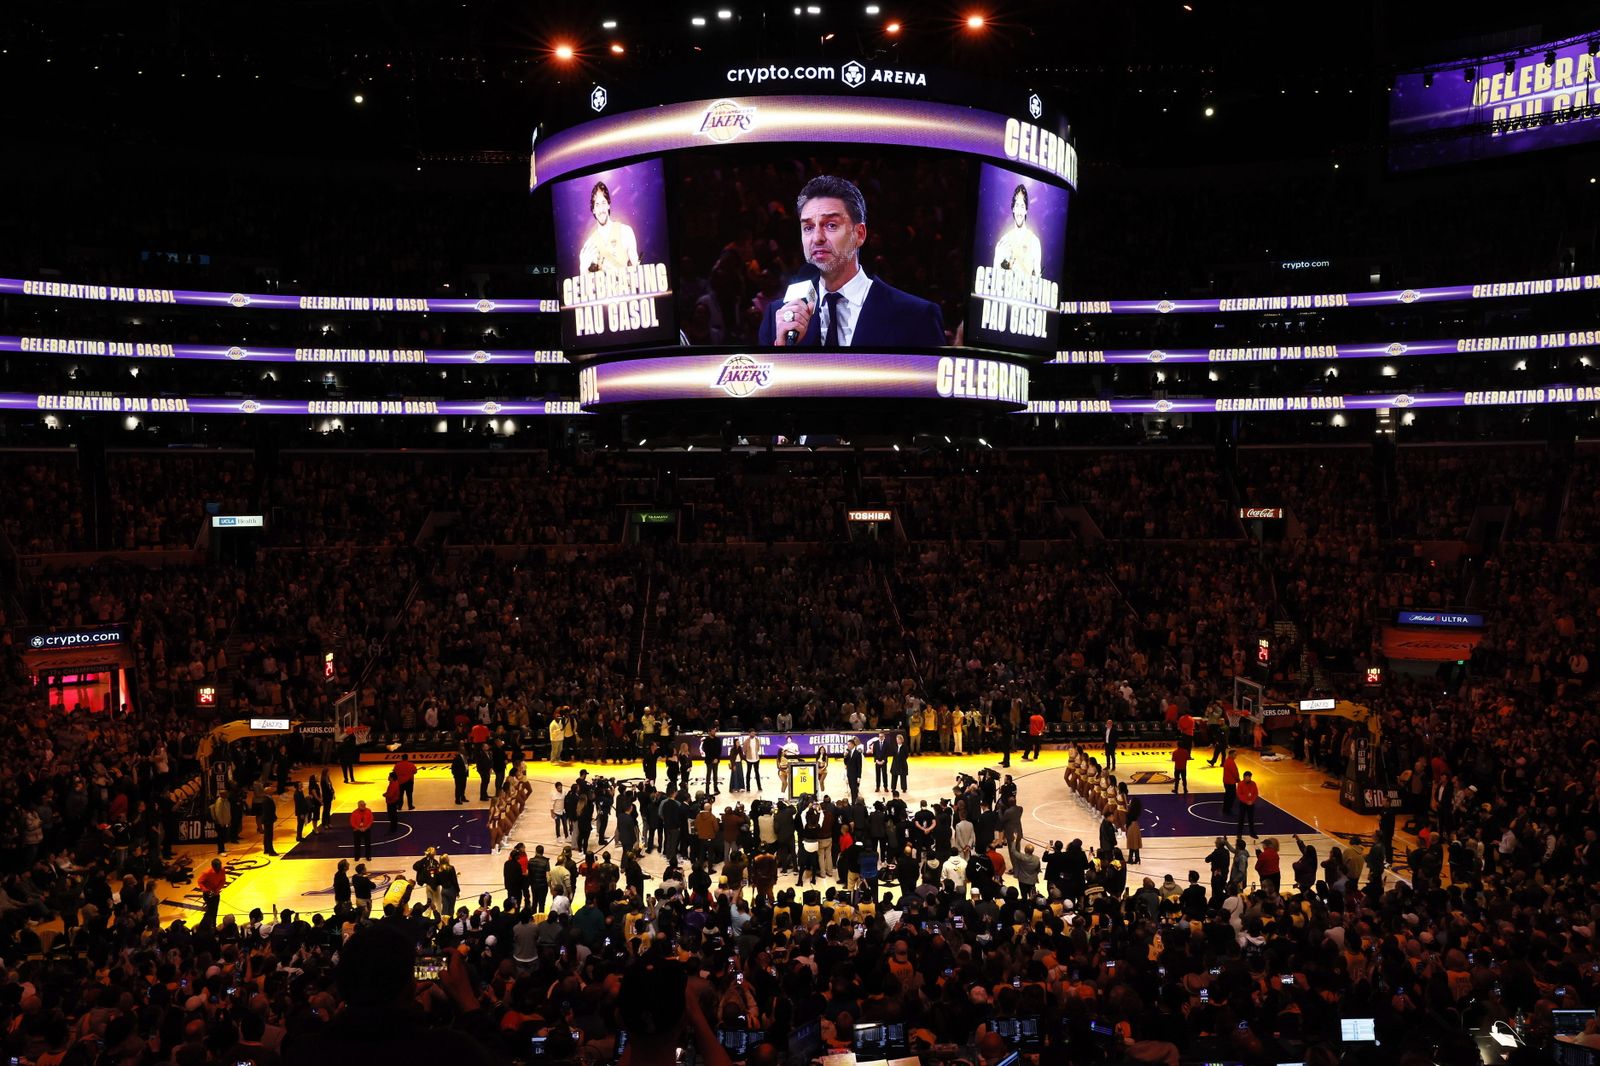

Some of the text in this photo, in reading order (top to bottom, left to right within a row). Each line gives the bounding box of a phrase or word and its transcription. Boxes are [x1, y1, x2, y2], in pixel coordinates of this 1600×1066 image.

[727, 65, 927, 86] crypto.com ARENA
[1473, 53, 1600, 106] CELEBRA
[700, 112, 752, 132] LAKERS
[23, 280, 176, 303] CELEBRATING PAU GASOL
[563, 263, 669, 306] CELEBRATING
[975, 266, 1059, 310] CELEBRATING
[1472, 280, 1552, 298] CELEBRATING
[1555, 277, 1580, 292] PAU
[300, 296, 430, 311] CELEBRATING PAU GASOL
[1219, 294, 1348, 311] CELEBRATING PAU GASOL
[575, 298, 659, 336] PAU GASOL
[981, 300, 1048, 339] PAU GASOL
[20, 337, 175, 357] CELEBRATING PAU GASOL
[1457, 335, 1537, 352] CELEBRATING
[1540, 333, 1565, 348] PAU
[295, 349, 428, 363] CELEBRATING PAU GASOL
[1208, 345, 1338, 361] CELEBRATING PAU GASOL
[716, 366, 770, 387] LAKERS
[37, 395, 190, 412] CELEBRATING PAU GASOL
[1215, 396, 1345, 411] CELEBRATING PAU GASOL
[1464, 390, 1544, 405] CELEBRATING
[1547, 388, 1572, 402] PAU
[308, 402, 438, 415] CELEBRATING PAU GASOL
[1059, 401, 1077, 412] PAU
[1080, 400, 1112, 412] GASOL
[849, 512, 891, 520] TOSHIBA
[46, 632, 120, 646] crypto.com
[1367, 674, 1378, 682] 24
[200, 694, 212, 702] 24
